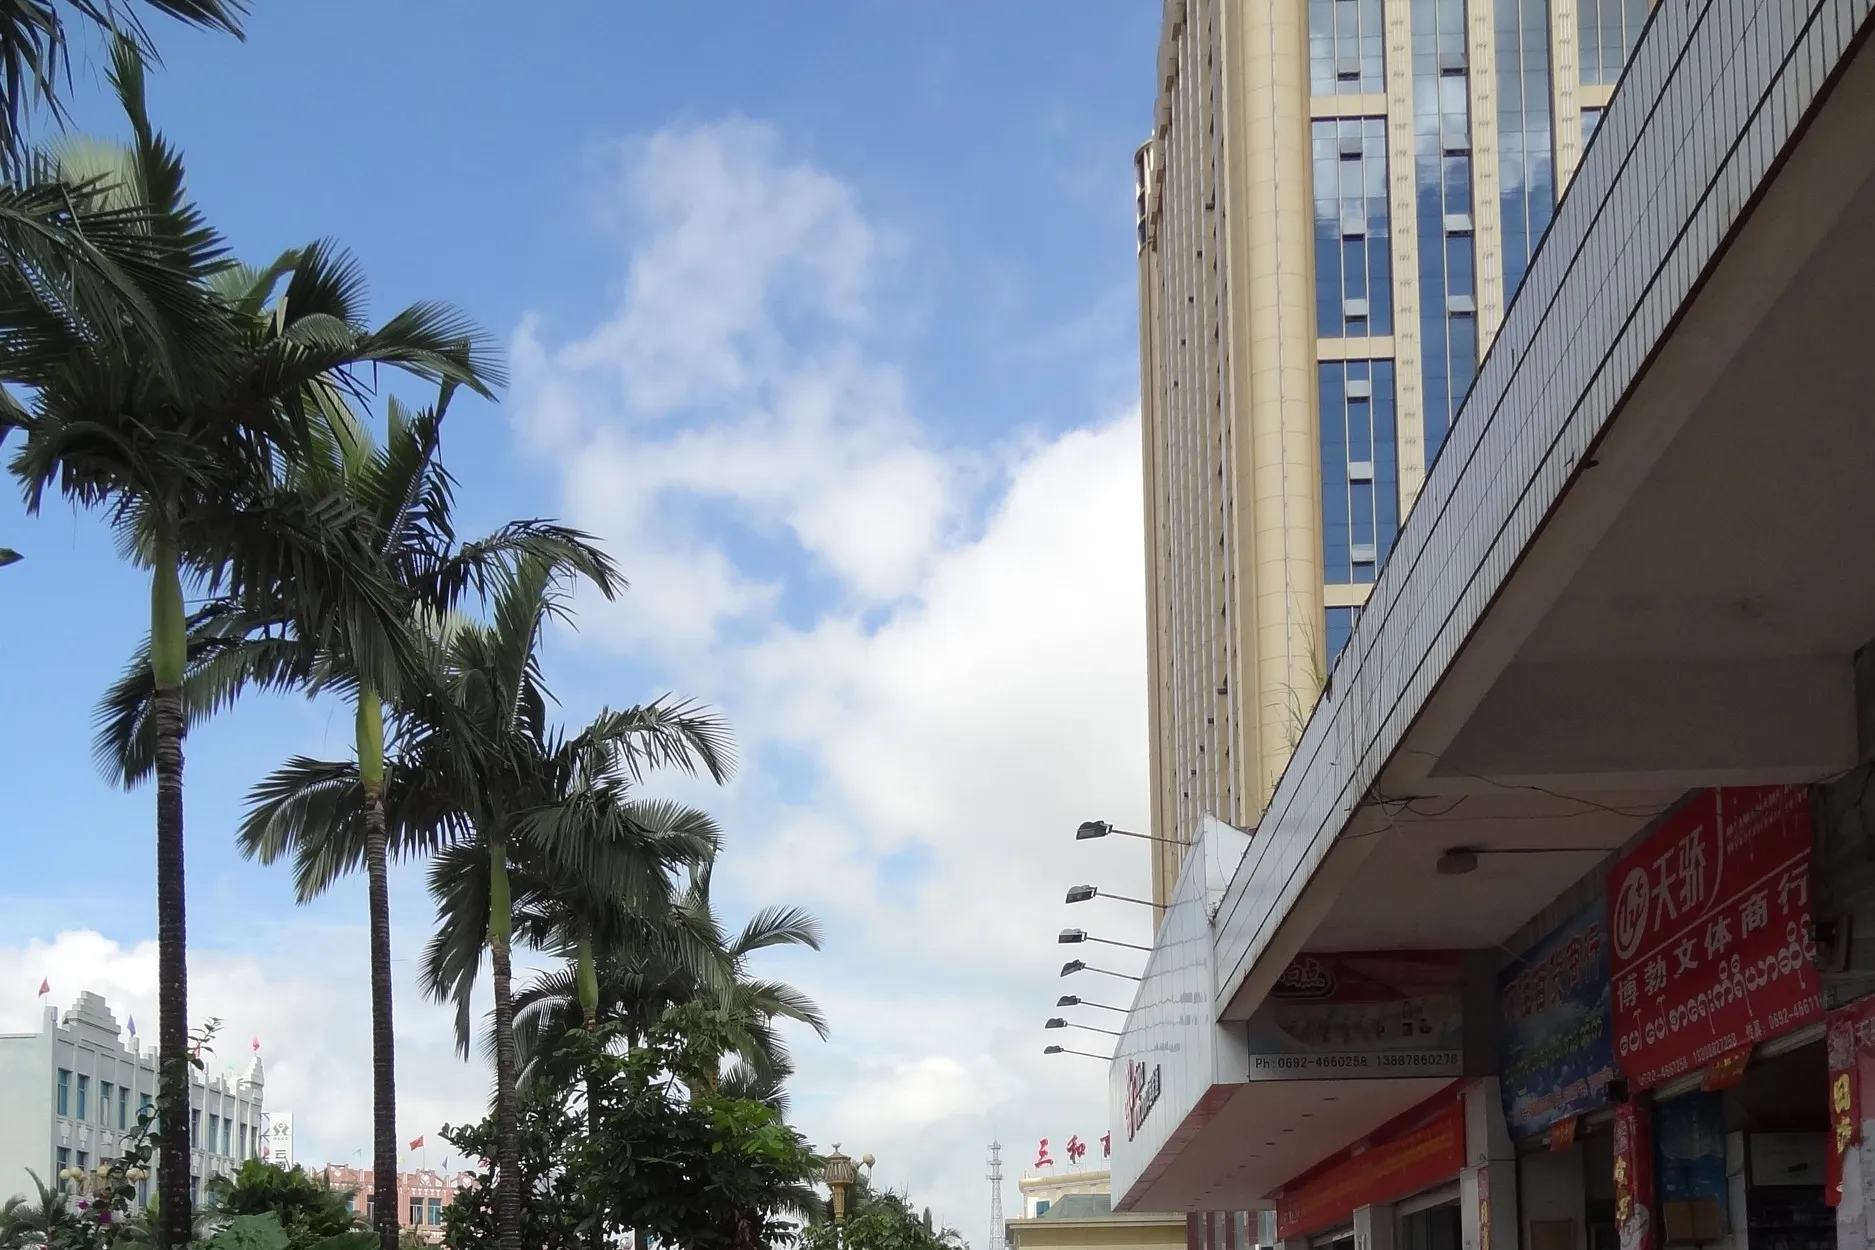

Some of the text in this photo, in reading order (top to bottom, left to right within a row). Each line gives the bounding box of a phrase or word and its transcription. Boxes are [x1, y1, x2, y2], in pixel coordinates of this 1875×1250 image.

[1651, 823, 1707, 933] 天骄
[1616, 862, 1810, 1012] 博勃文体商行
[1376, 1053, 1458, 1066] 13887860278
